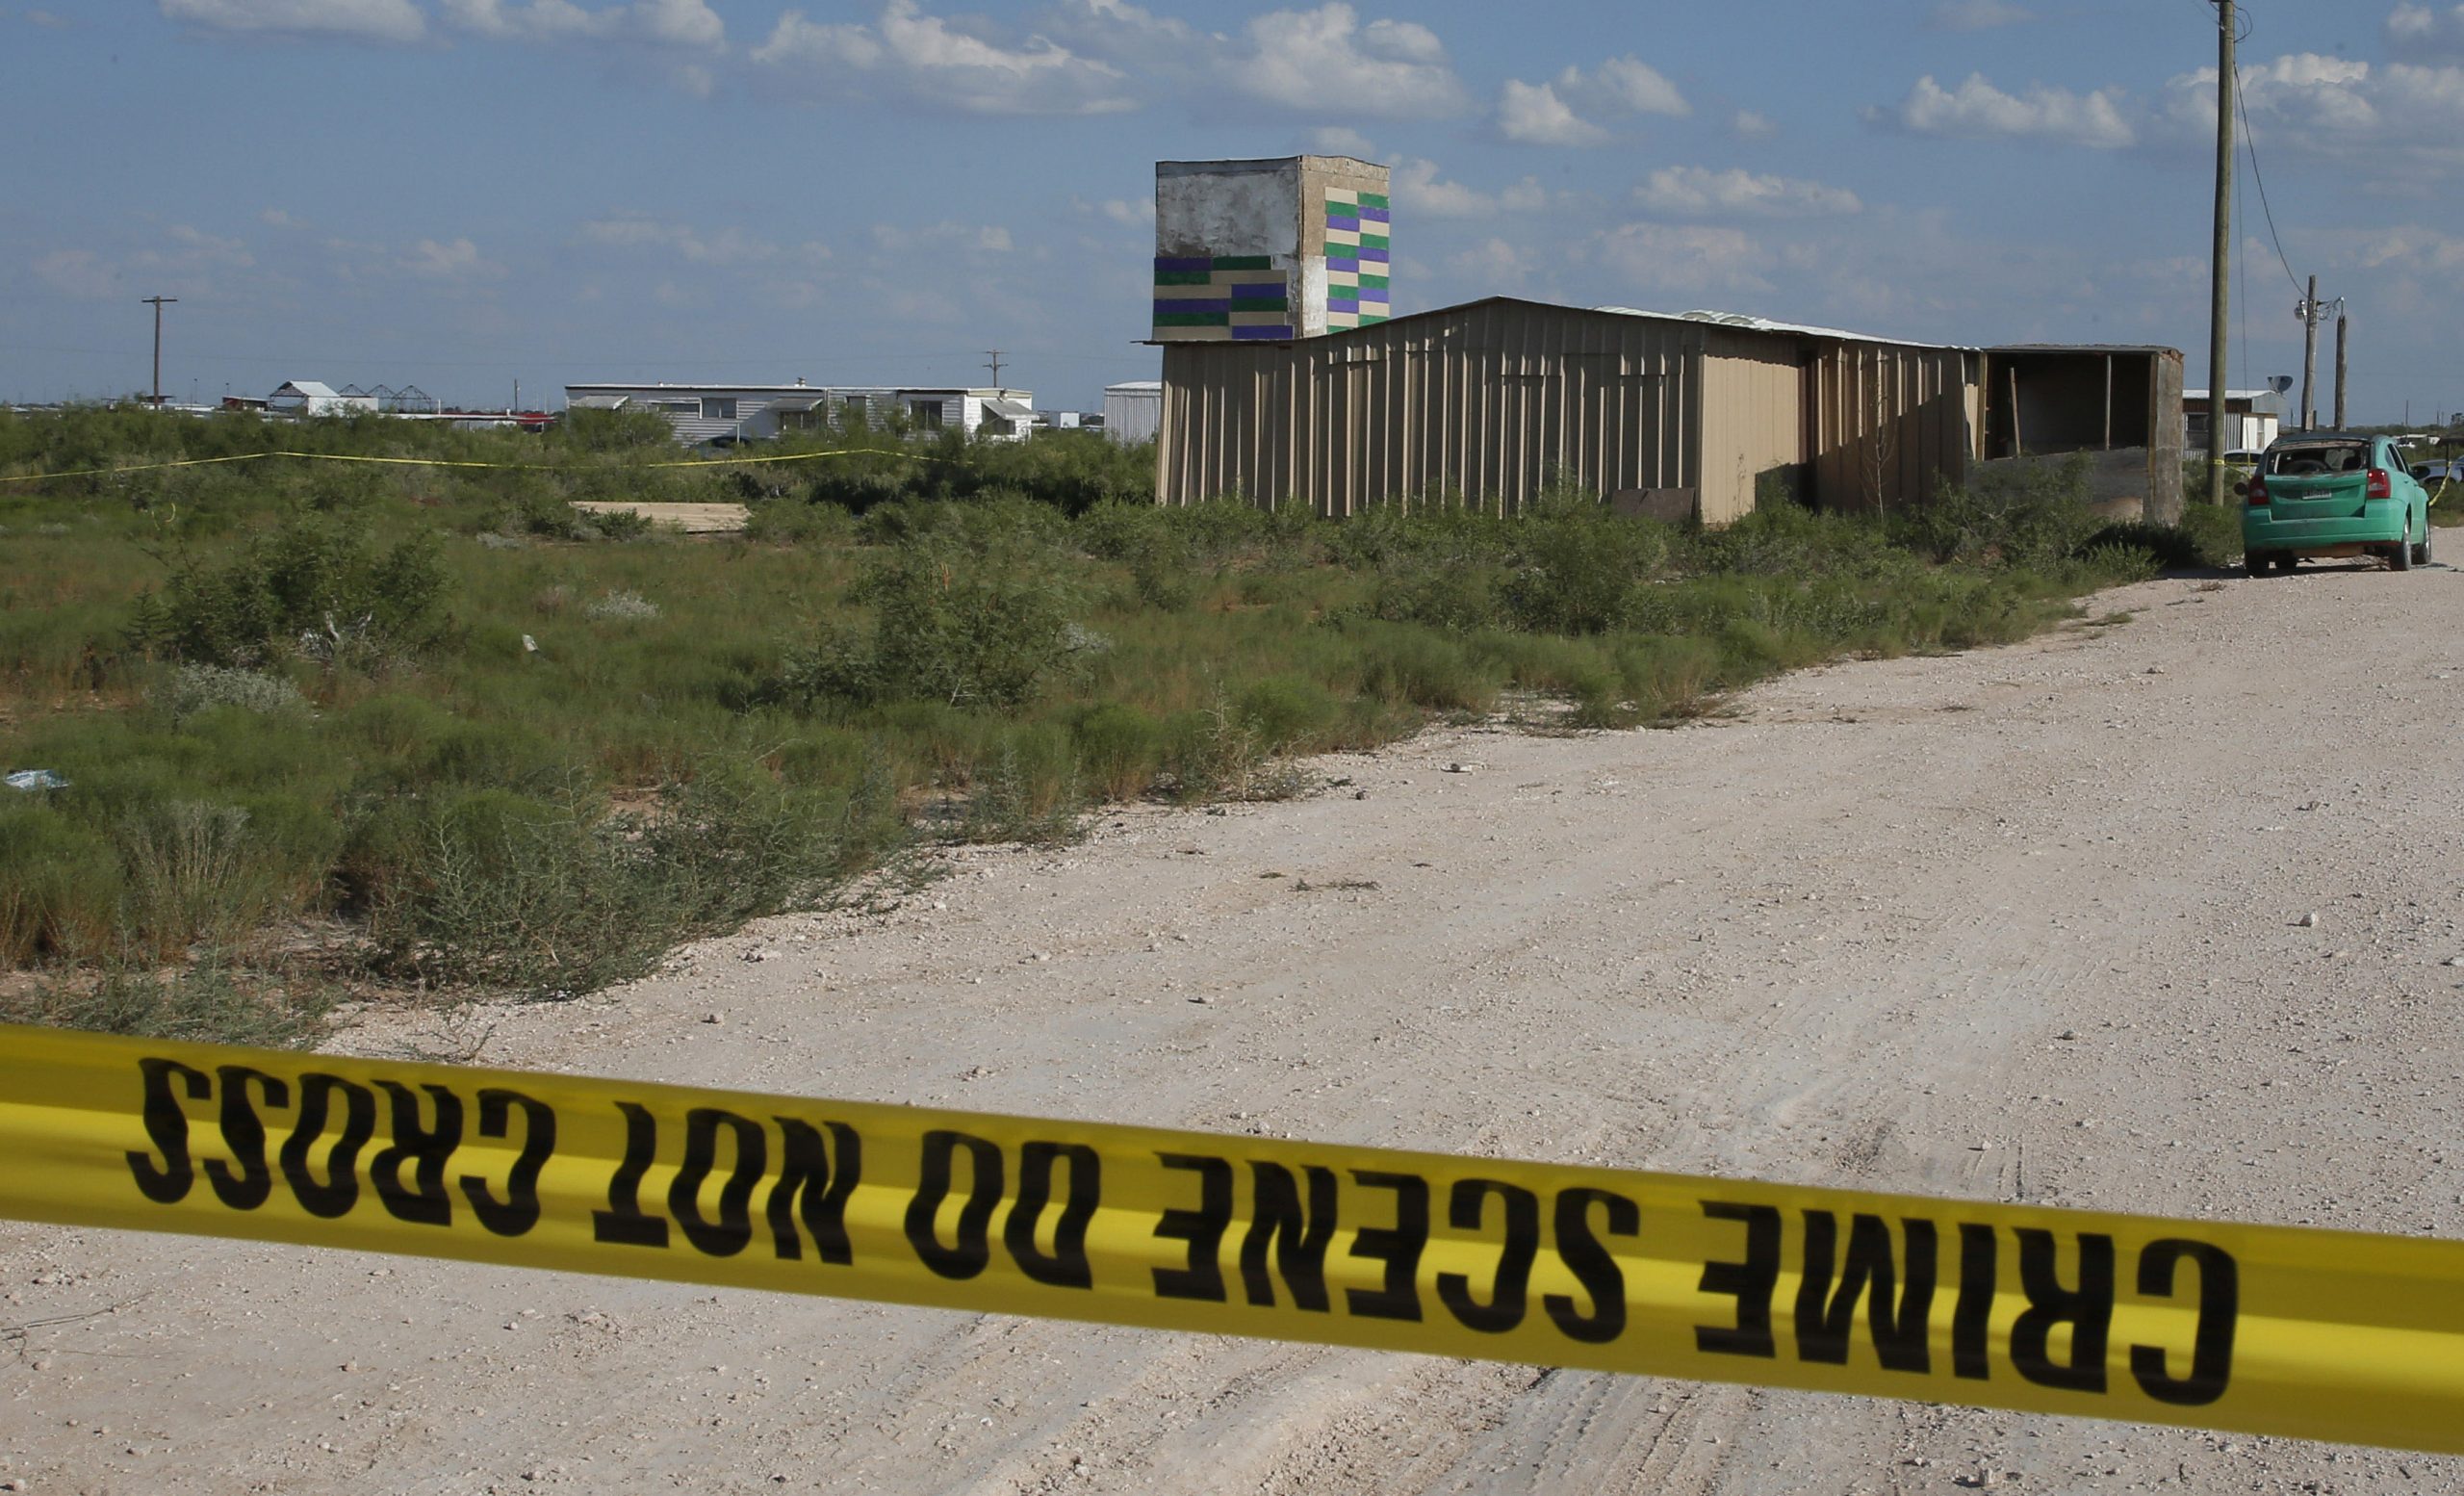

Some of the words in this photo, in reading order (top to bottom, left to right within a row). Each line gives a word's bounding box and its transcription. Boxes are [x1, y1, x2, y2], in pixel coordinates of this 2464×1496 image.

[126, 1058, 555, 1237] CROSS
[592, 1102, 860, 1265] NOT
[905, 1130, 1100, 1290] DO
[1152, 1153, 1639, 1344] SCENE
[1695, 1201, 2238, 1406] CRIME
